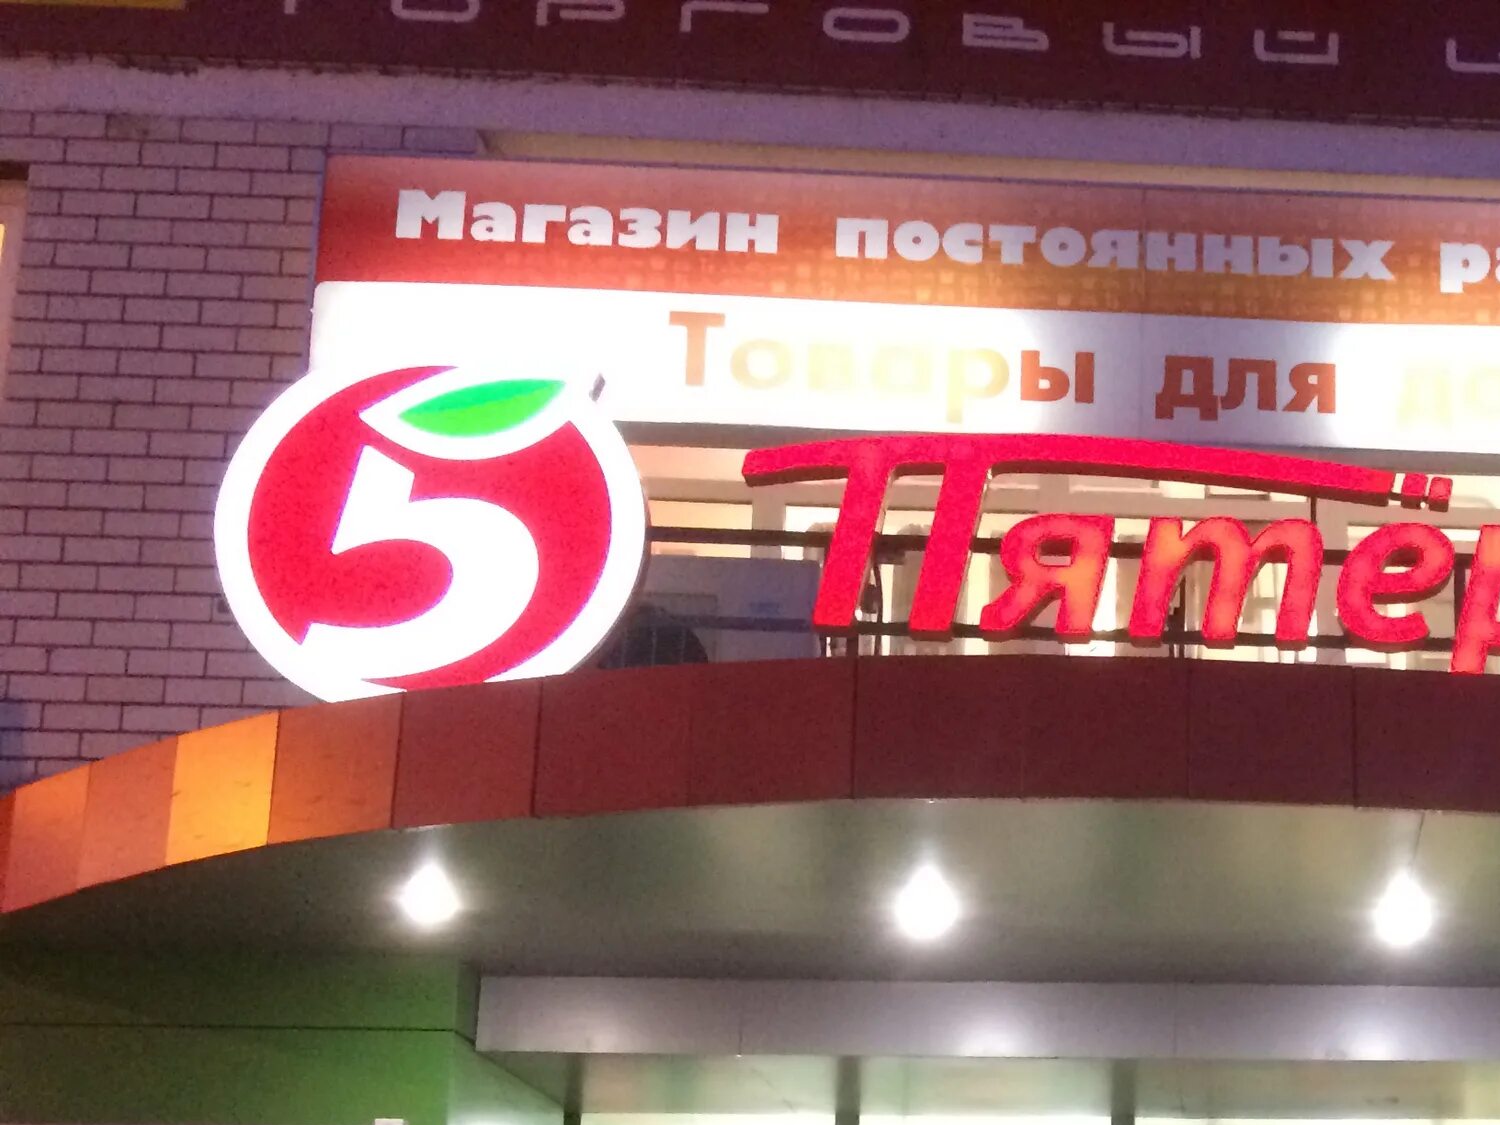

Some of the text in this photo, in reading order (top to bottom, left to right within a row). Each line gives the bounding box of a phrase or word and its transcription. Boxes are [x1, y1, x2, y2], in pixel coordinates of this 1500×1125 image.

[395, 188, 779, 254] Магазин
[836, 215, 1394, 283] постоянных
[668, 310, 1094, 422] Товары
[1154, 354, 1337, 420] для
